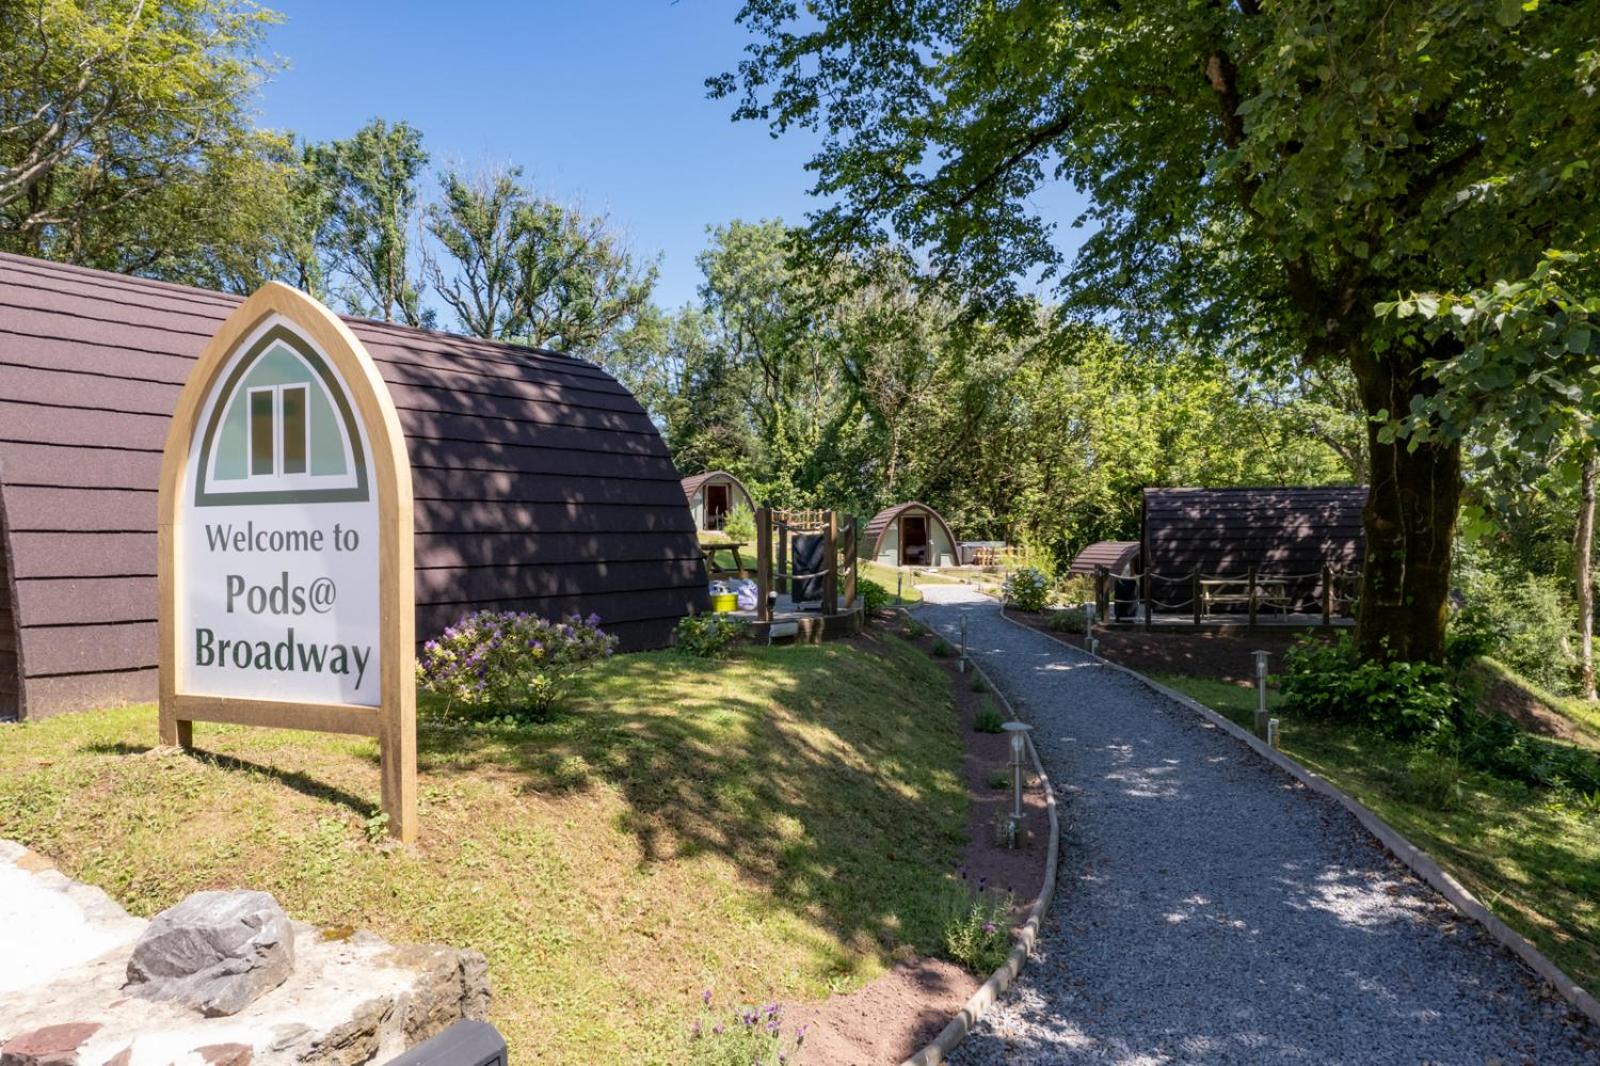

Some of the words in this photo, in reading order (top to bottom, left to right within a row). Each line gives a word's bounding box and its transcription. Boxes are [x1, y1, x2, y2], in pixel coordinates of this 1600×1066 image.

[205, 521, 324, 552] Welcome
[333, 523, 360, 552] to
[226, 571, 337, 615] Pods@
[195, 628, 372, 691] Broadway
